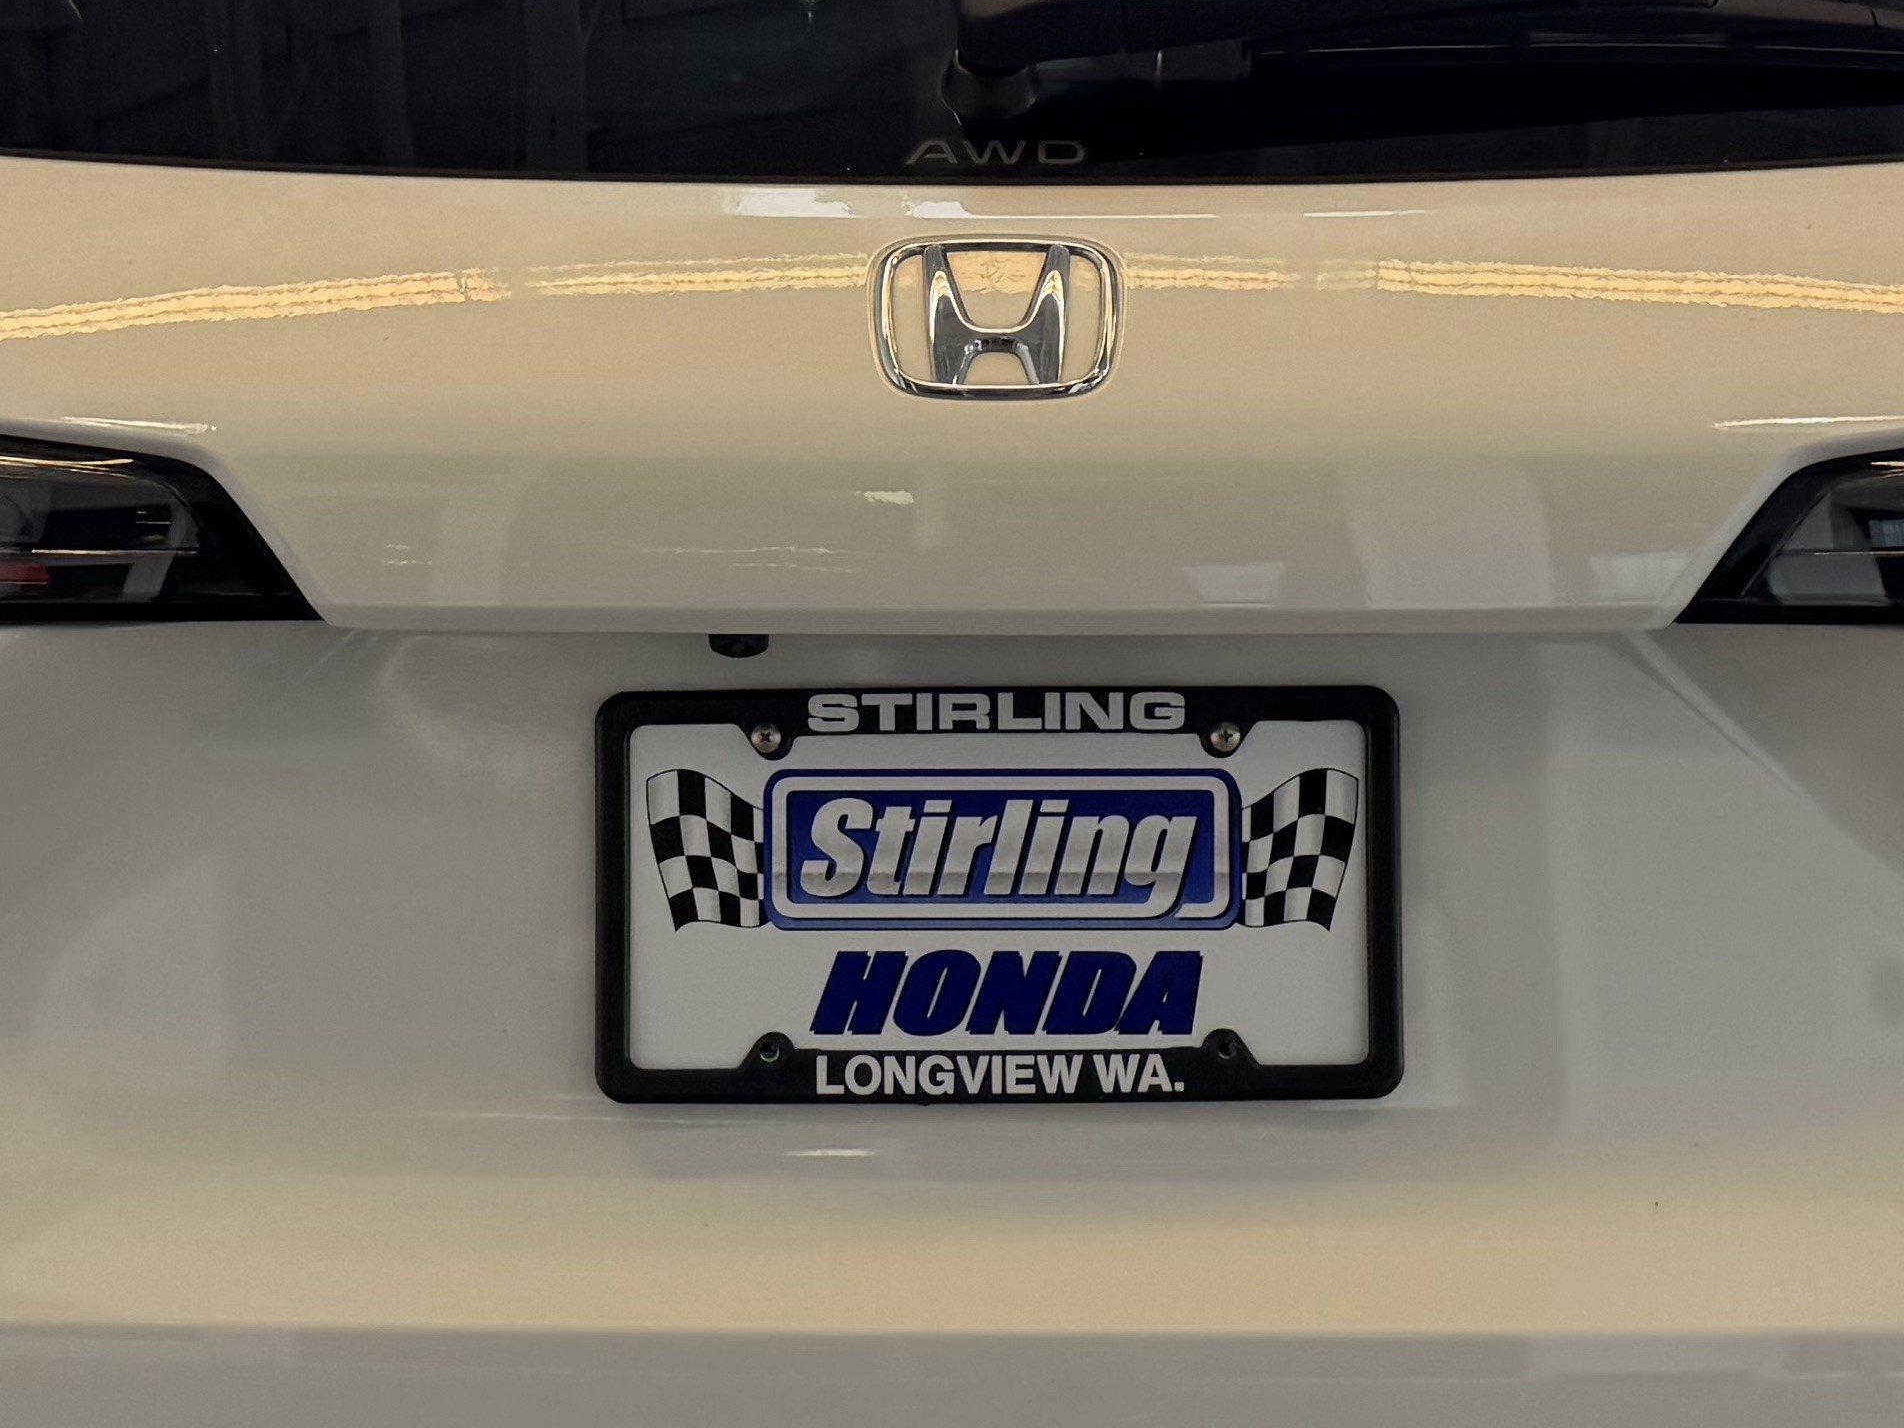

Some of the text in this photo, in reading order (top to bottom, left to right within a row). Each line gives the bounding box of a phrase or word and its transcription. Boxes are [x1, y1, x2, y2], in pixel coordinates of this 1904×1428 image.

[905, 140, 1088, 165] AWD
[807, 691, 1186, 732] STIRLING
[800, 797, 1197, 918] Stirling
[809, 949, 1203, 1036] HONDA
[816, 1053, 1185, 1095] LONGVIEW WA.
